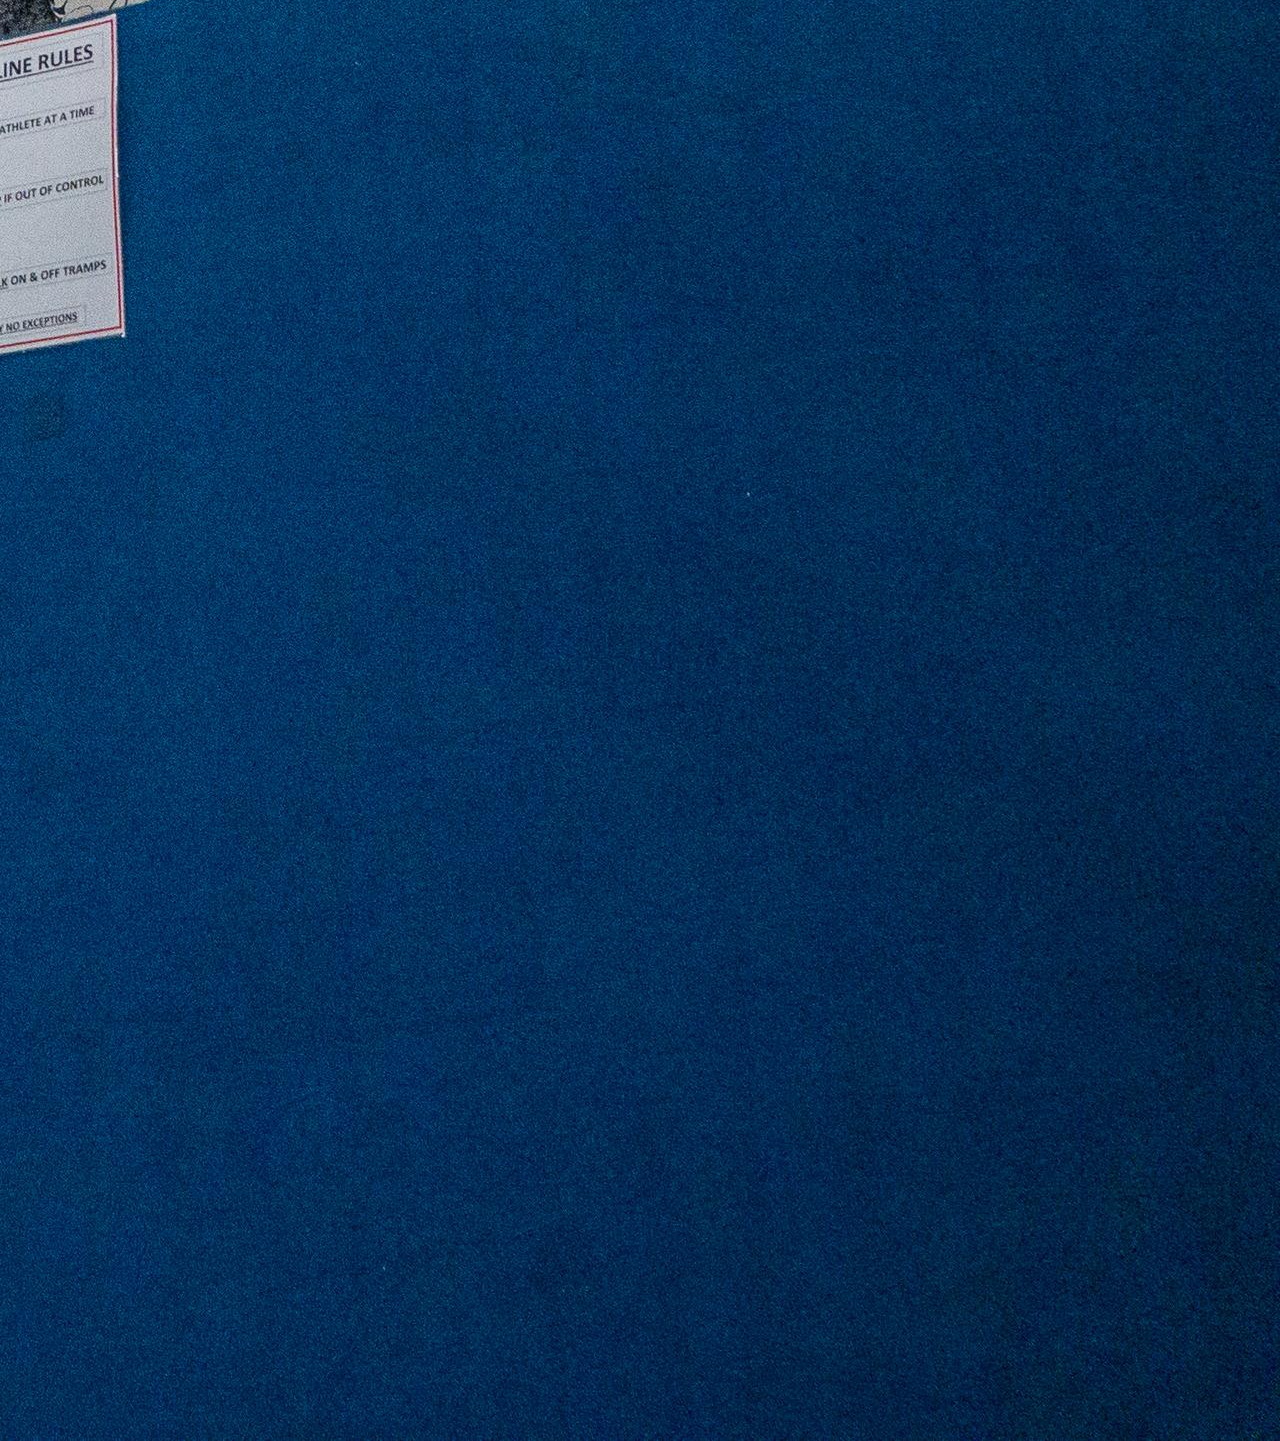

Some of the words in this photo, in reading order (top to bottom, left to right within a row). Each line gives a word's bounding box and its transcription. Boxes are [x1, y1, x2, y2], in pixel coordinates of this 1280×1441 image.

[39, 44, 93, 70] RULES
[0, 118, 41, 134] ATHLETE
[44, 114, 57, 125] AT
[60, 113, 67, 121] A
[70, 106, 94, 119] TIME
[4, 194, 12, 203] IF
[15, 188, 37, 200] OUT
[40, 185, 52, 196] OF
[56, 175, 104, 192] CONTROL
[10, 274, 26, 285] ON
[30, 273, 38, 281] &
[40, 269, 60, 280] OFF
[63, 260, 107, 276] TRAMPS
[6, 321, 20, 331] NO
[22, 312, 78, 329] EXCEPTIONS
